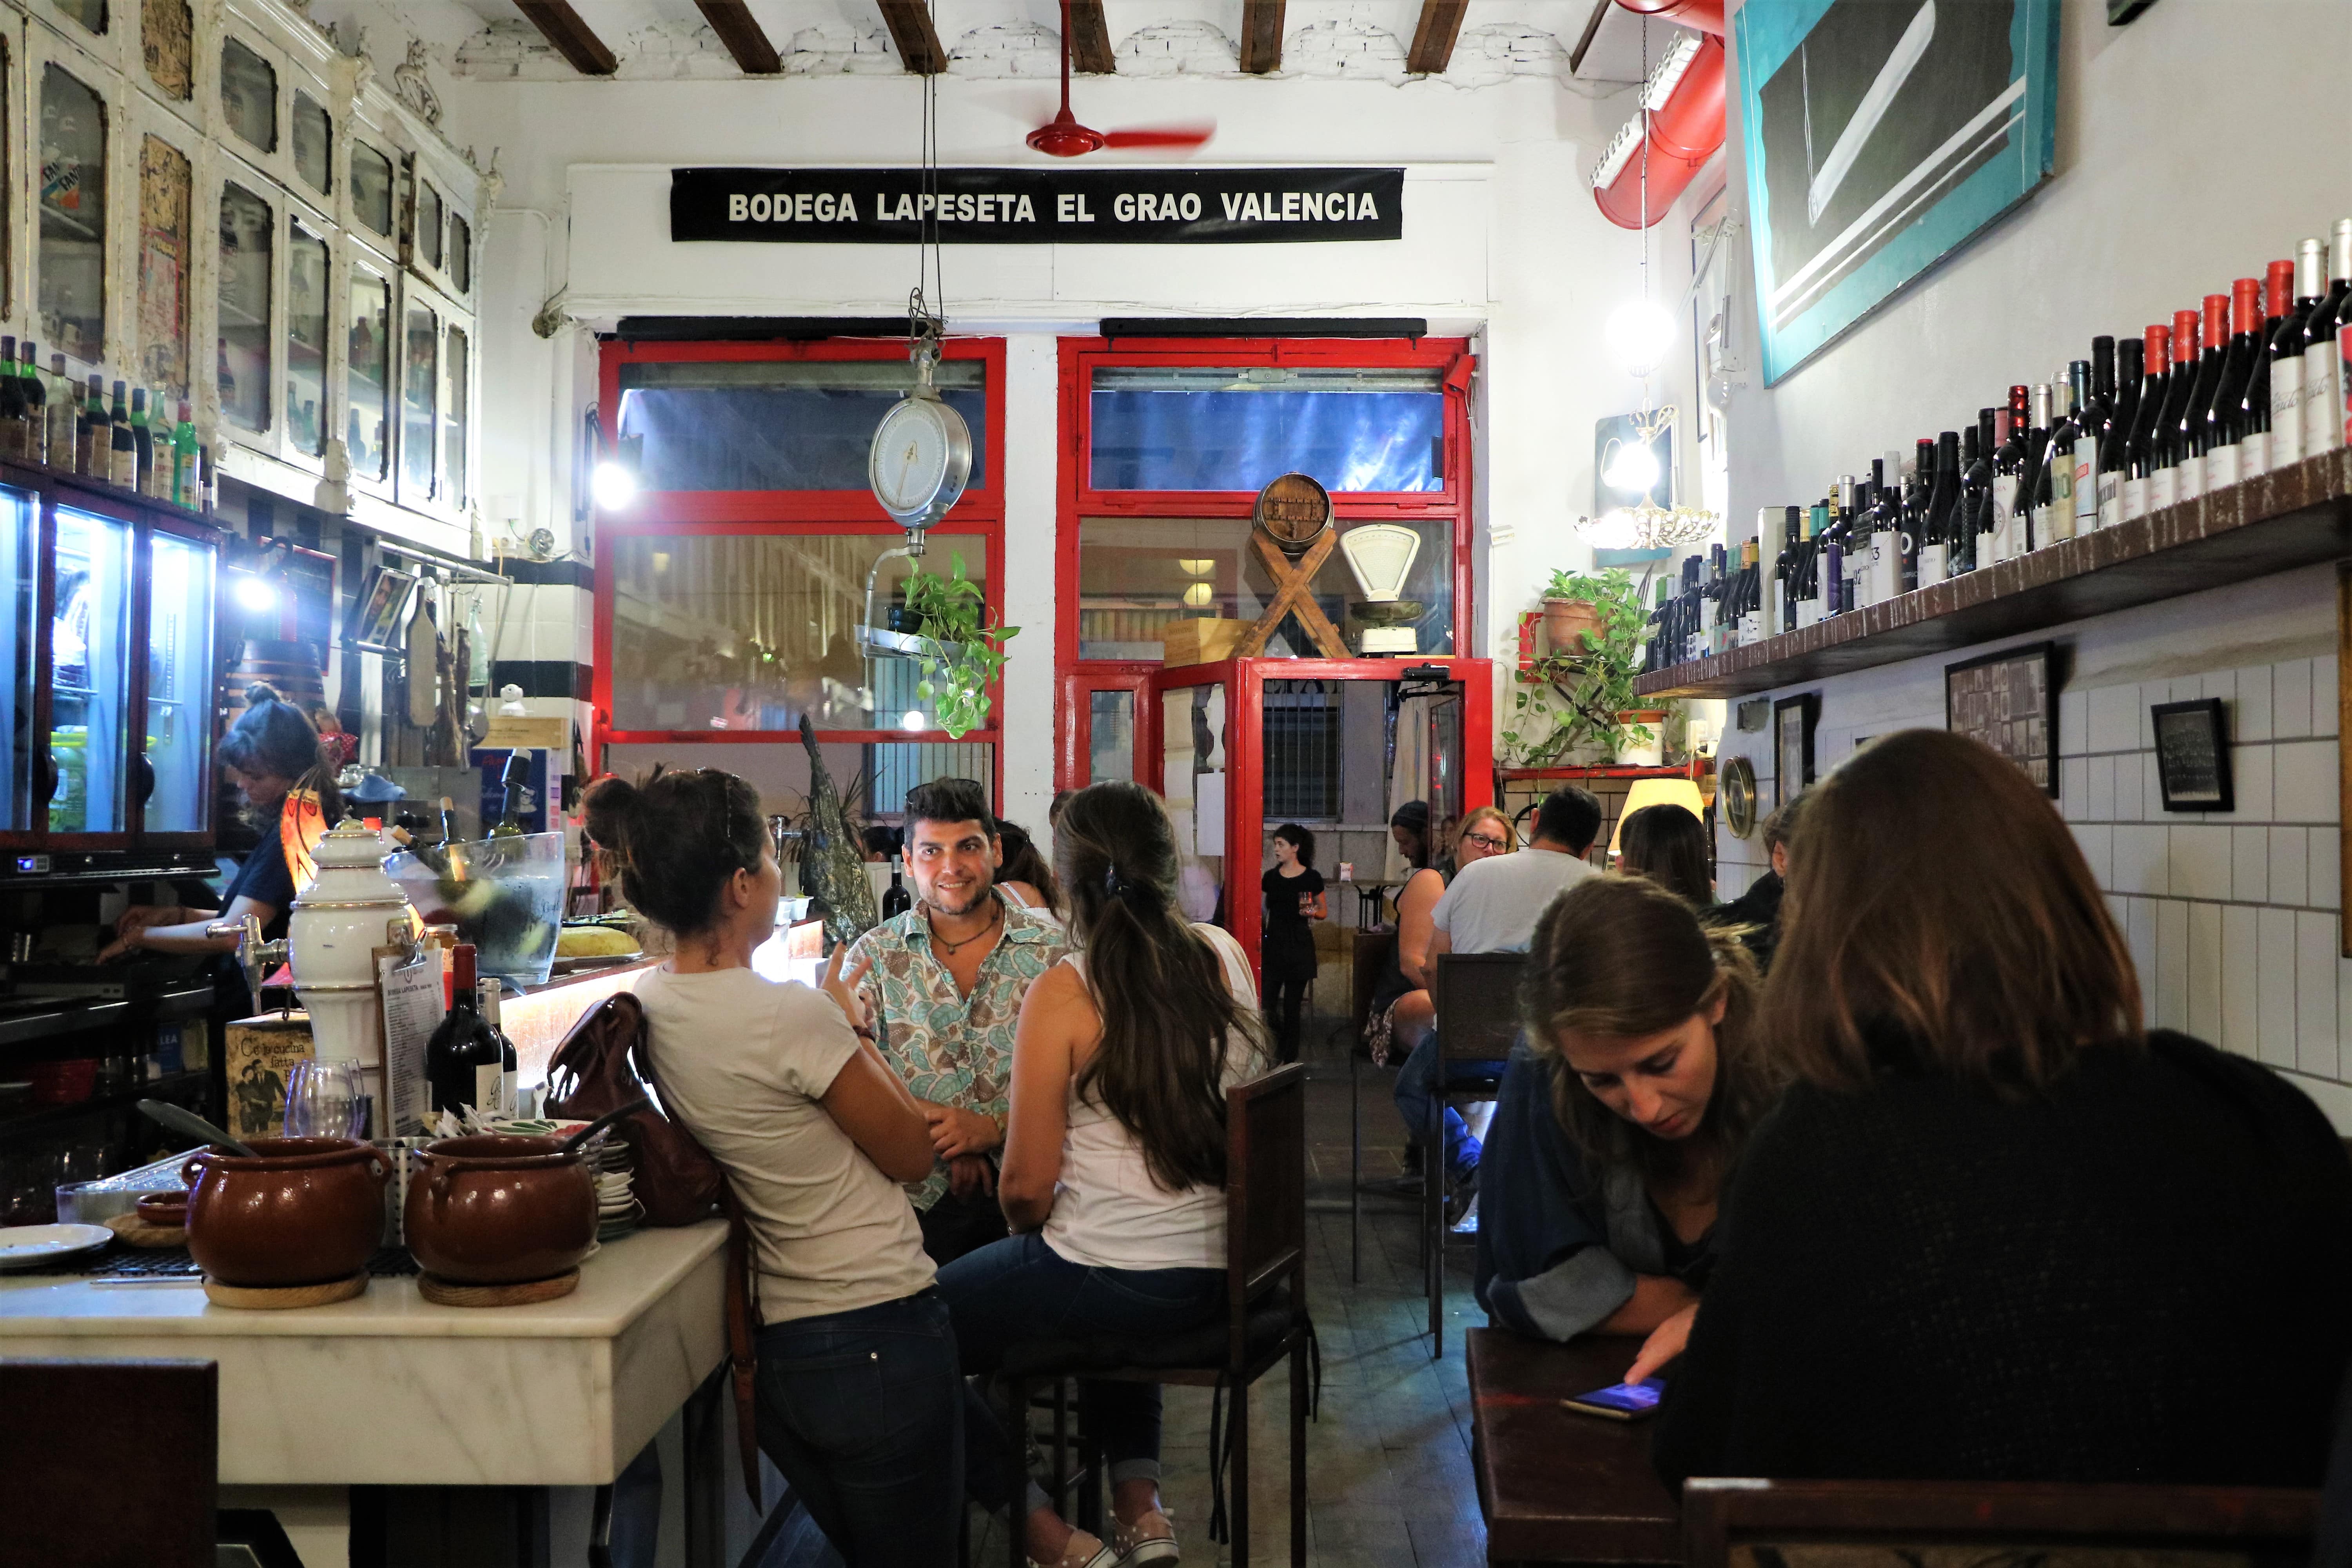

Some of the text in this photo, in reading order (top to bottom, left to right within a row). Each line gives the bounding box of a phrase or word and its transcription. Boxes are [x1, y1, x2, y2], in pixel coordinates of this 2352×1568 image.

[729, 193, 1378, 222] BODEGA LAPESETA EL GRAO VALENCIA
[273, 1044, 305, 1054] cucina
[270, 1056, 294, 1068] fatta
